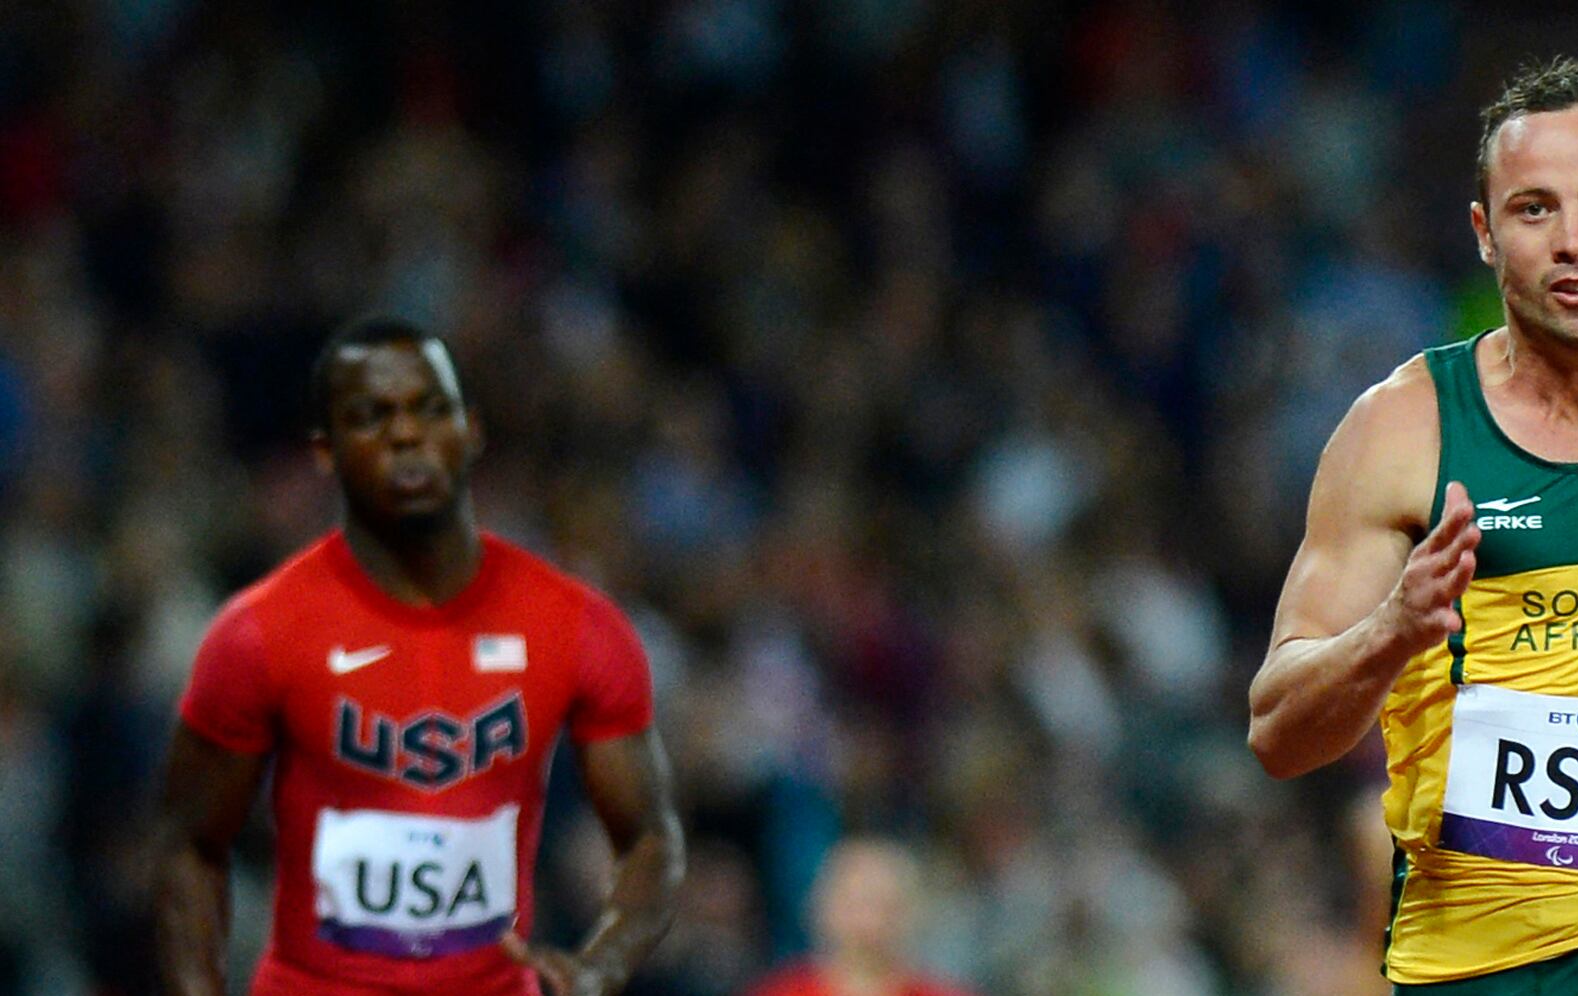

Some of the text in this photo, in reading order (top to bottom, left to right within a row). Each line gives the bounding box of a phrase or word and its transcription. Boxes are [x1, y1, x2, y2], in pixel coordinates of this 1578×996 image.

[1476, 515, 1543, 530] ERKE
[1548, 711, 1576, 725] BT
[334, 688, 528, 790] USA
[1532, 831, 1567, 844] London
[356, 858, 488, 918] USA
